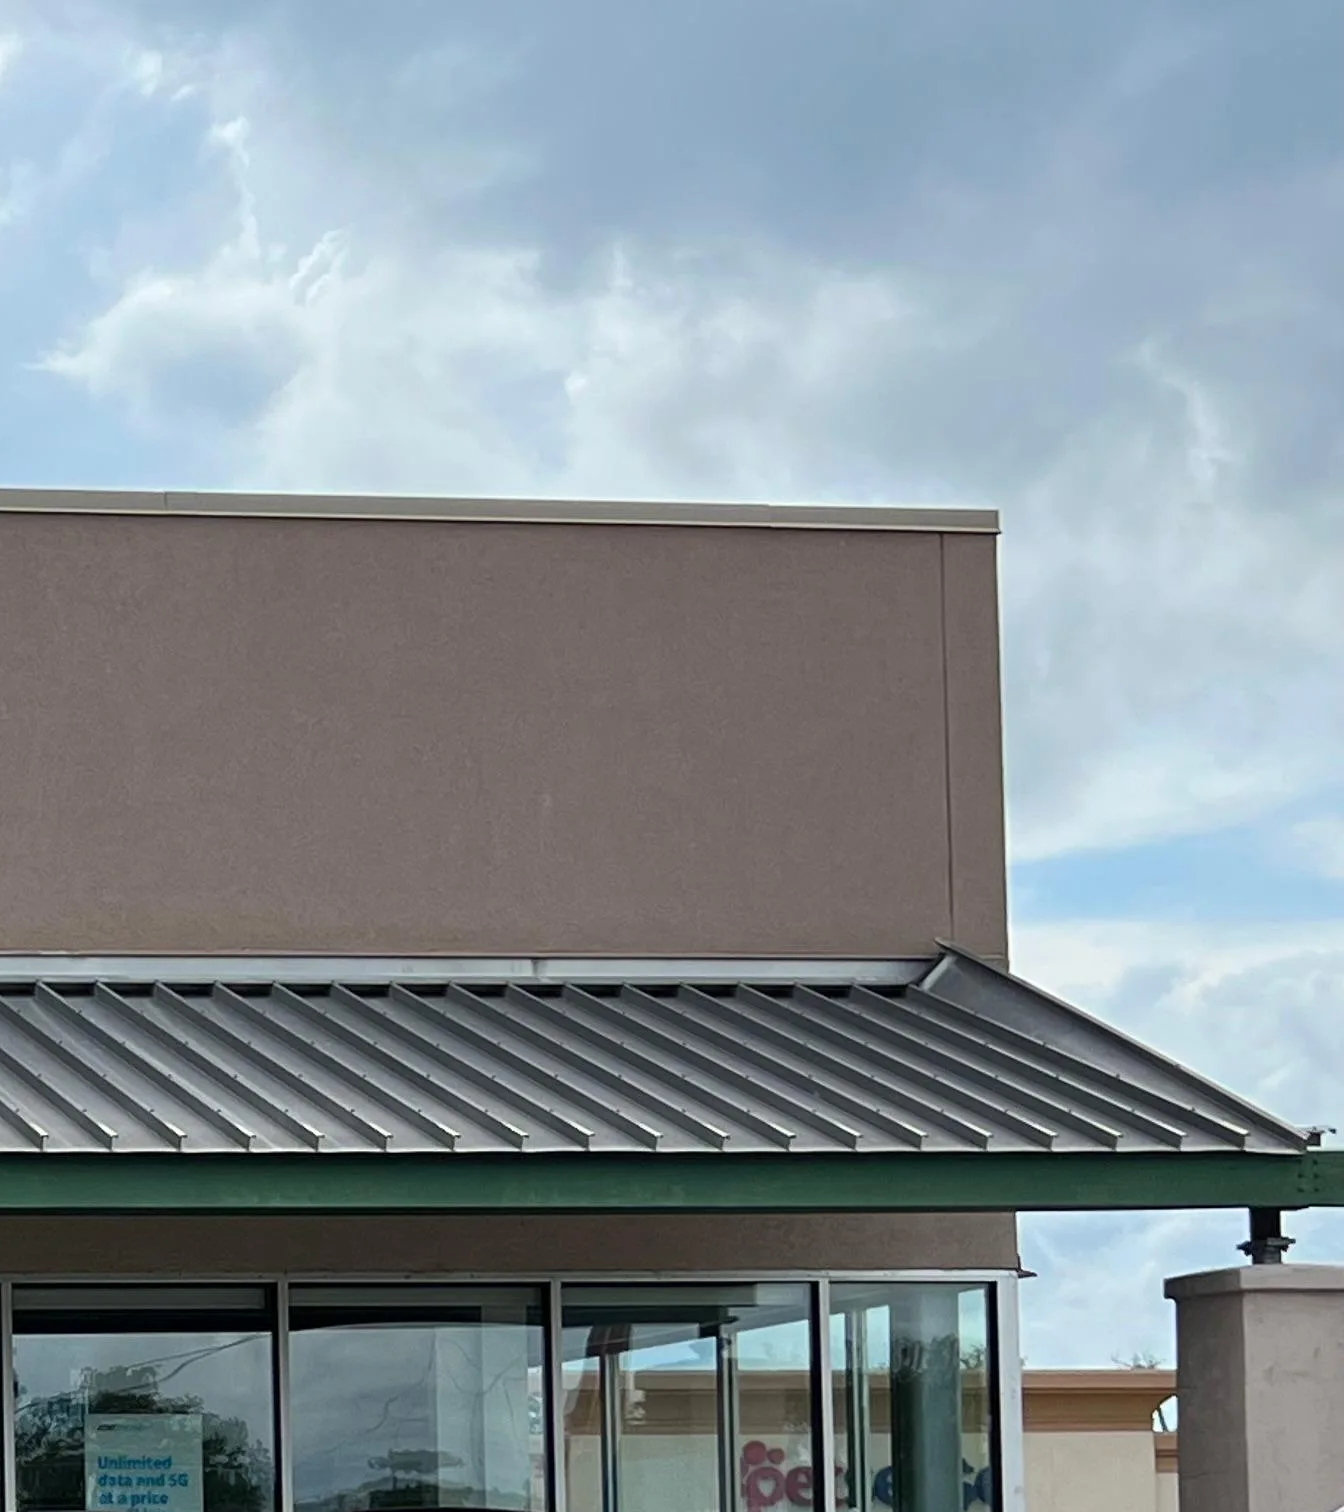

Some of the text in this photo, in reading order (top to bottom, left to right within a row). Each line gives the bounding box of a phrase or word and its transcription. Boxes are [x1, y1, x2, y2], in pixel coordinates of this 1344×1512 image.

[97, 1455, 172, 1469] Unlimited
[98, 1473, 189, 1487] data and 5G
[130, 1491, 169, 1507] price
